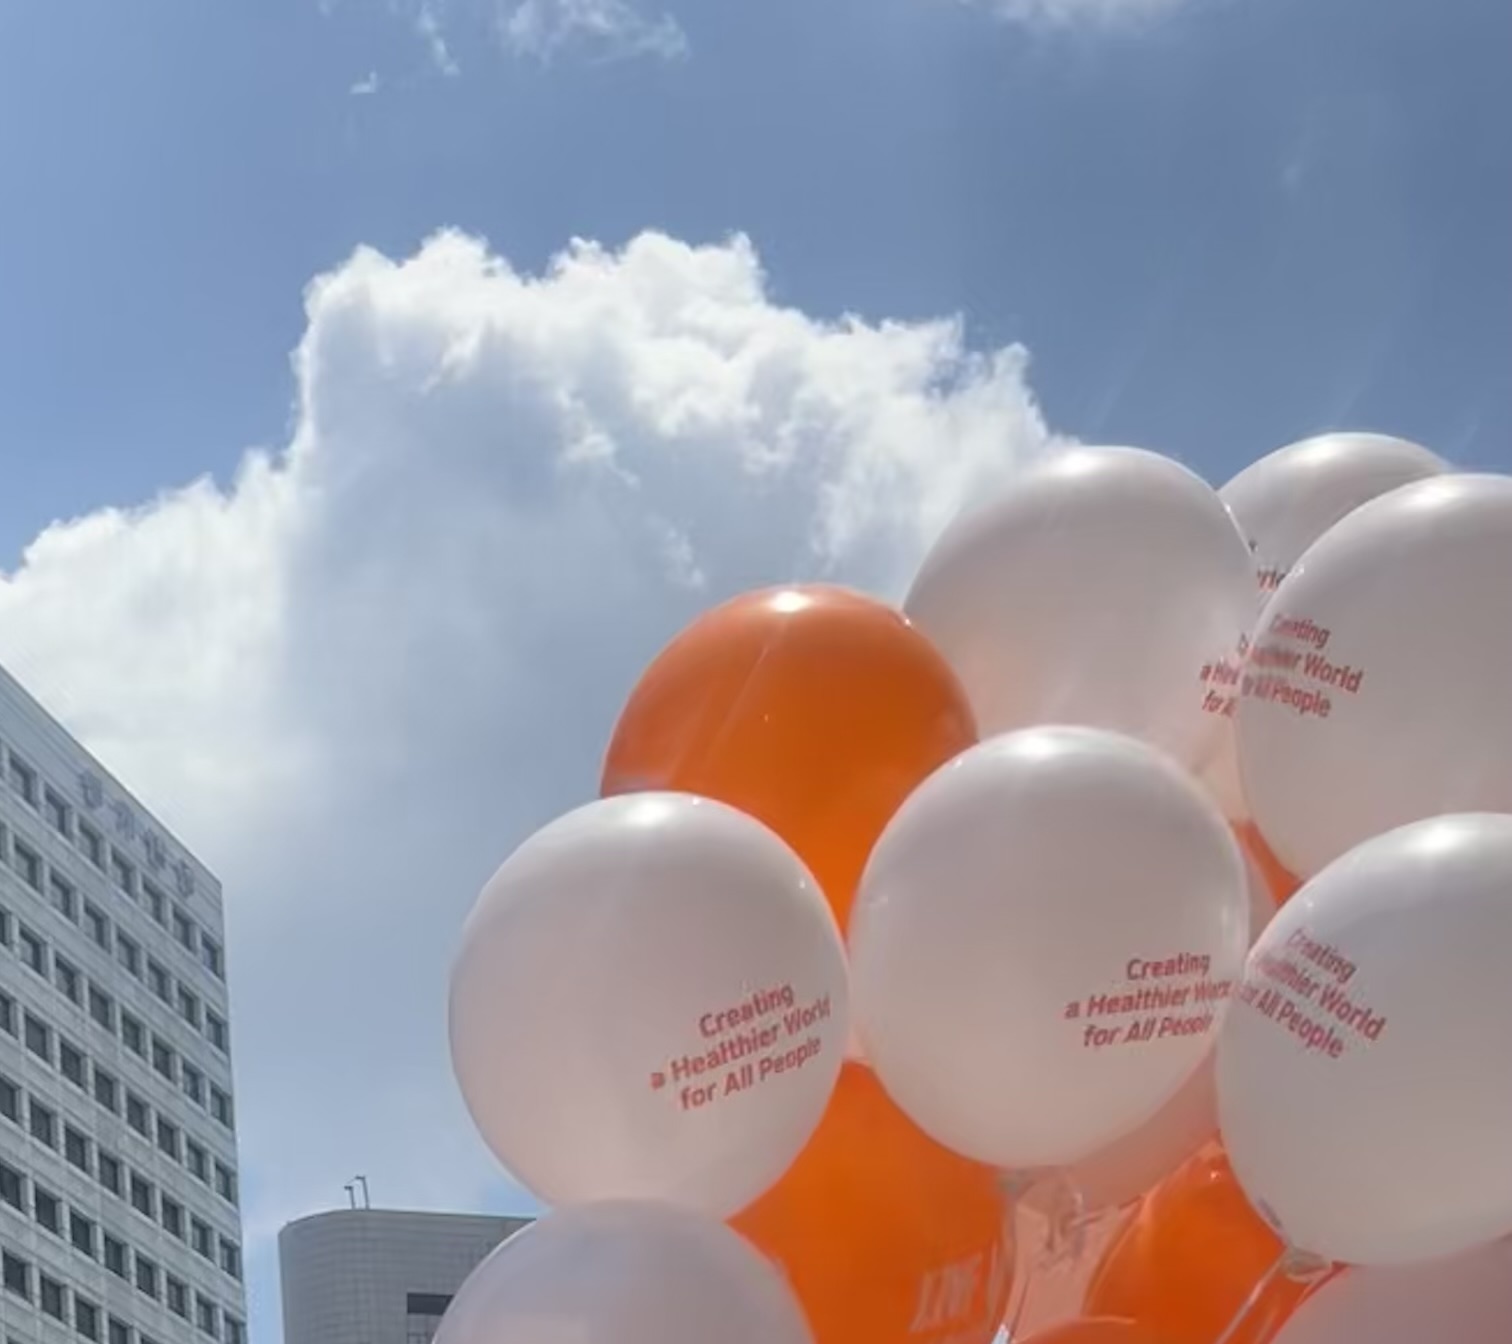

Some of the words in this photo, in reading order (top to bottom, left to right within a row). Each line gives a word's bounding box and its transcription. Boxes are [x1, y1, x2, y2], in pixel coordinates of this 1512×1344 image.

[699, 984, 794, 1037] Creating
[1064, 1001, 1080, 1019] a
[1087, 984, 1190, 1018] Healthier
[1276, 999, 1344, 1059] People
[1319, 983, 1387, 1041] World
[651, 1072, 666, 1089] a
[671, 1023, 780, 1080] Healthier
[1084, 1023, 1123, 1047] for
[1123, 1017, 1157, 1043] All
[680, 1083, 717, 1110] for
[724, 1063, 754, 1096] All
[759, 1036, 822, 1081] People
